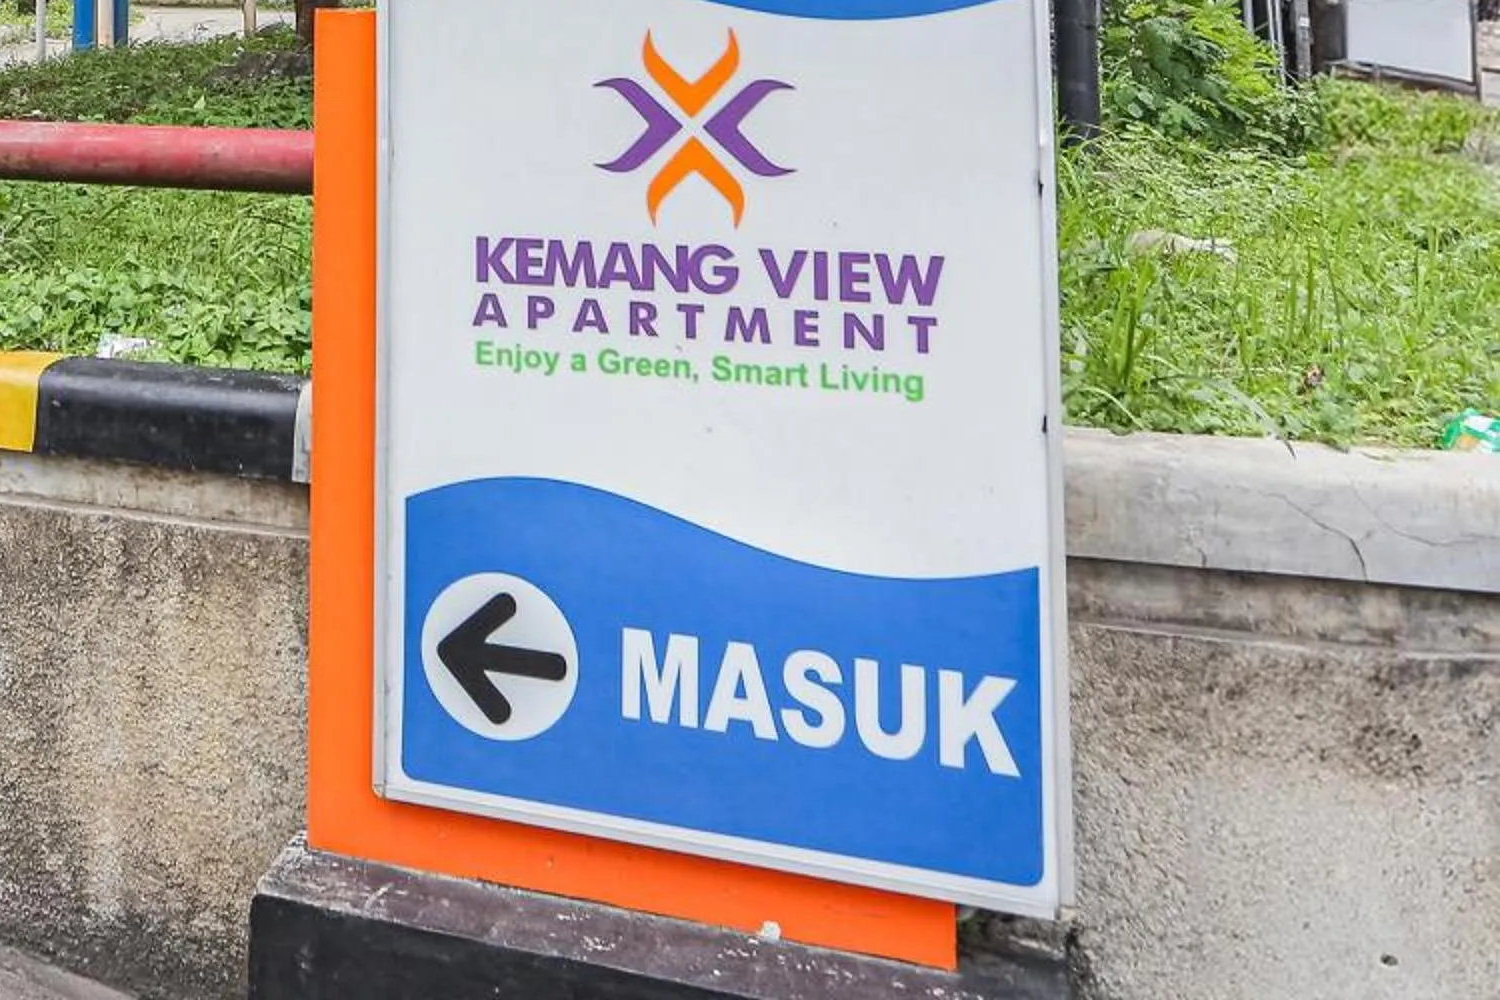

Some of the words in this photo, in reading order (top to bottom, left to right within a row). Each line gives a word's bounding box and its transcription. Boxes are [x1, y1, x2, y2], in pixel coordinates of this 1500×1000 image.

[476, 236, 740, 295] KEMANG
[758, 248, 946, 306] VIEW
[472, 293, 938, 354] APARTMENT
[475, 341, 559, 376] Enjoy
[570, 353, 588, 372] a
[597, 348, 700, 384] Green,
[711, 355, 809, 388] Smart
[820, 362, 925, 403] Living
[621, 627, 1021, 778] MASUK
